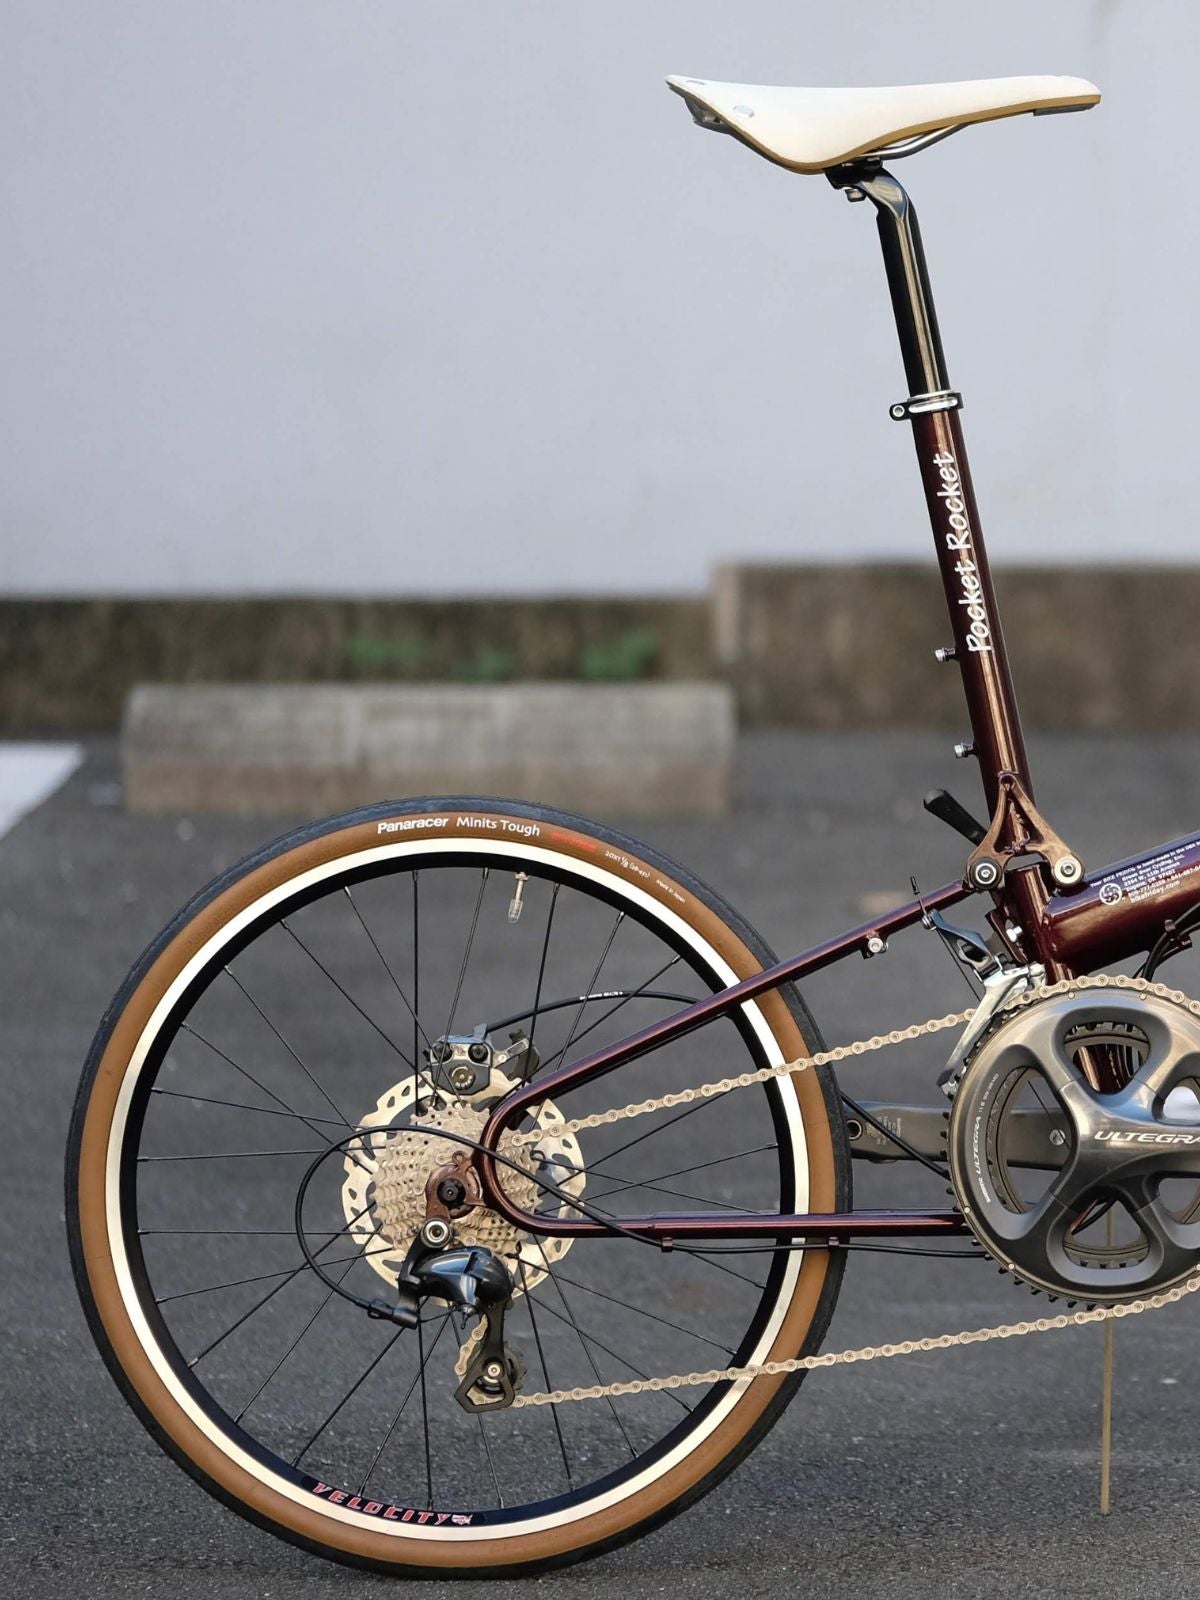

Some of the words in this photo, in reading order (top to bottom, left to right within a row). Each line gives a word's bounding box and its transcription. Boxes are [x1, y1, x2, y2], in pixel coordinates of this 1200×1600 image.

[933, 450, 972, 550] Rocket
[958, 558, 993, 652] Pocket
[377, 817, 449, 834] Panaracer
[456, 816, 498, 829] Minits
[500, 819, 541, 837] Tough
[1130, 881, 1180, 903] bikefriday.com
[973, 1116, 981, 1174] ULTEGRA
[312, 1482, 451, 1525] VELOCITY
